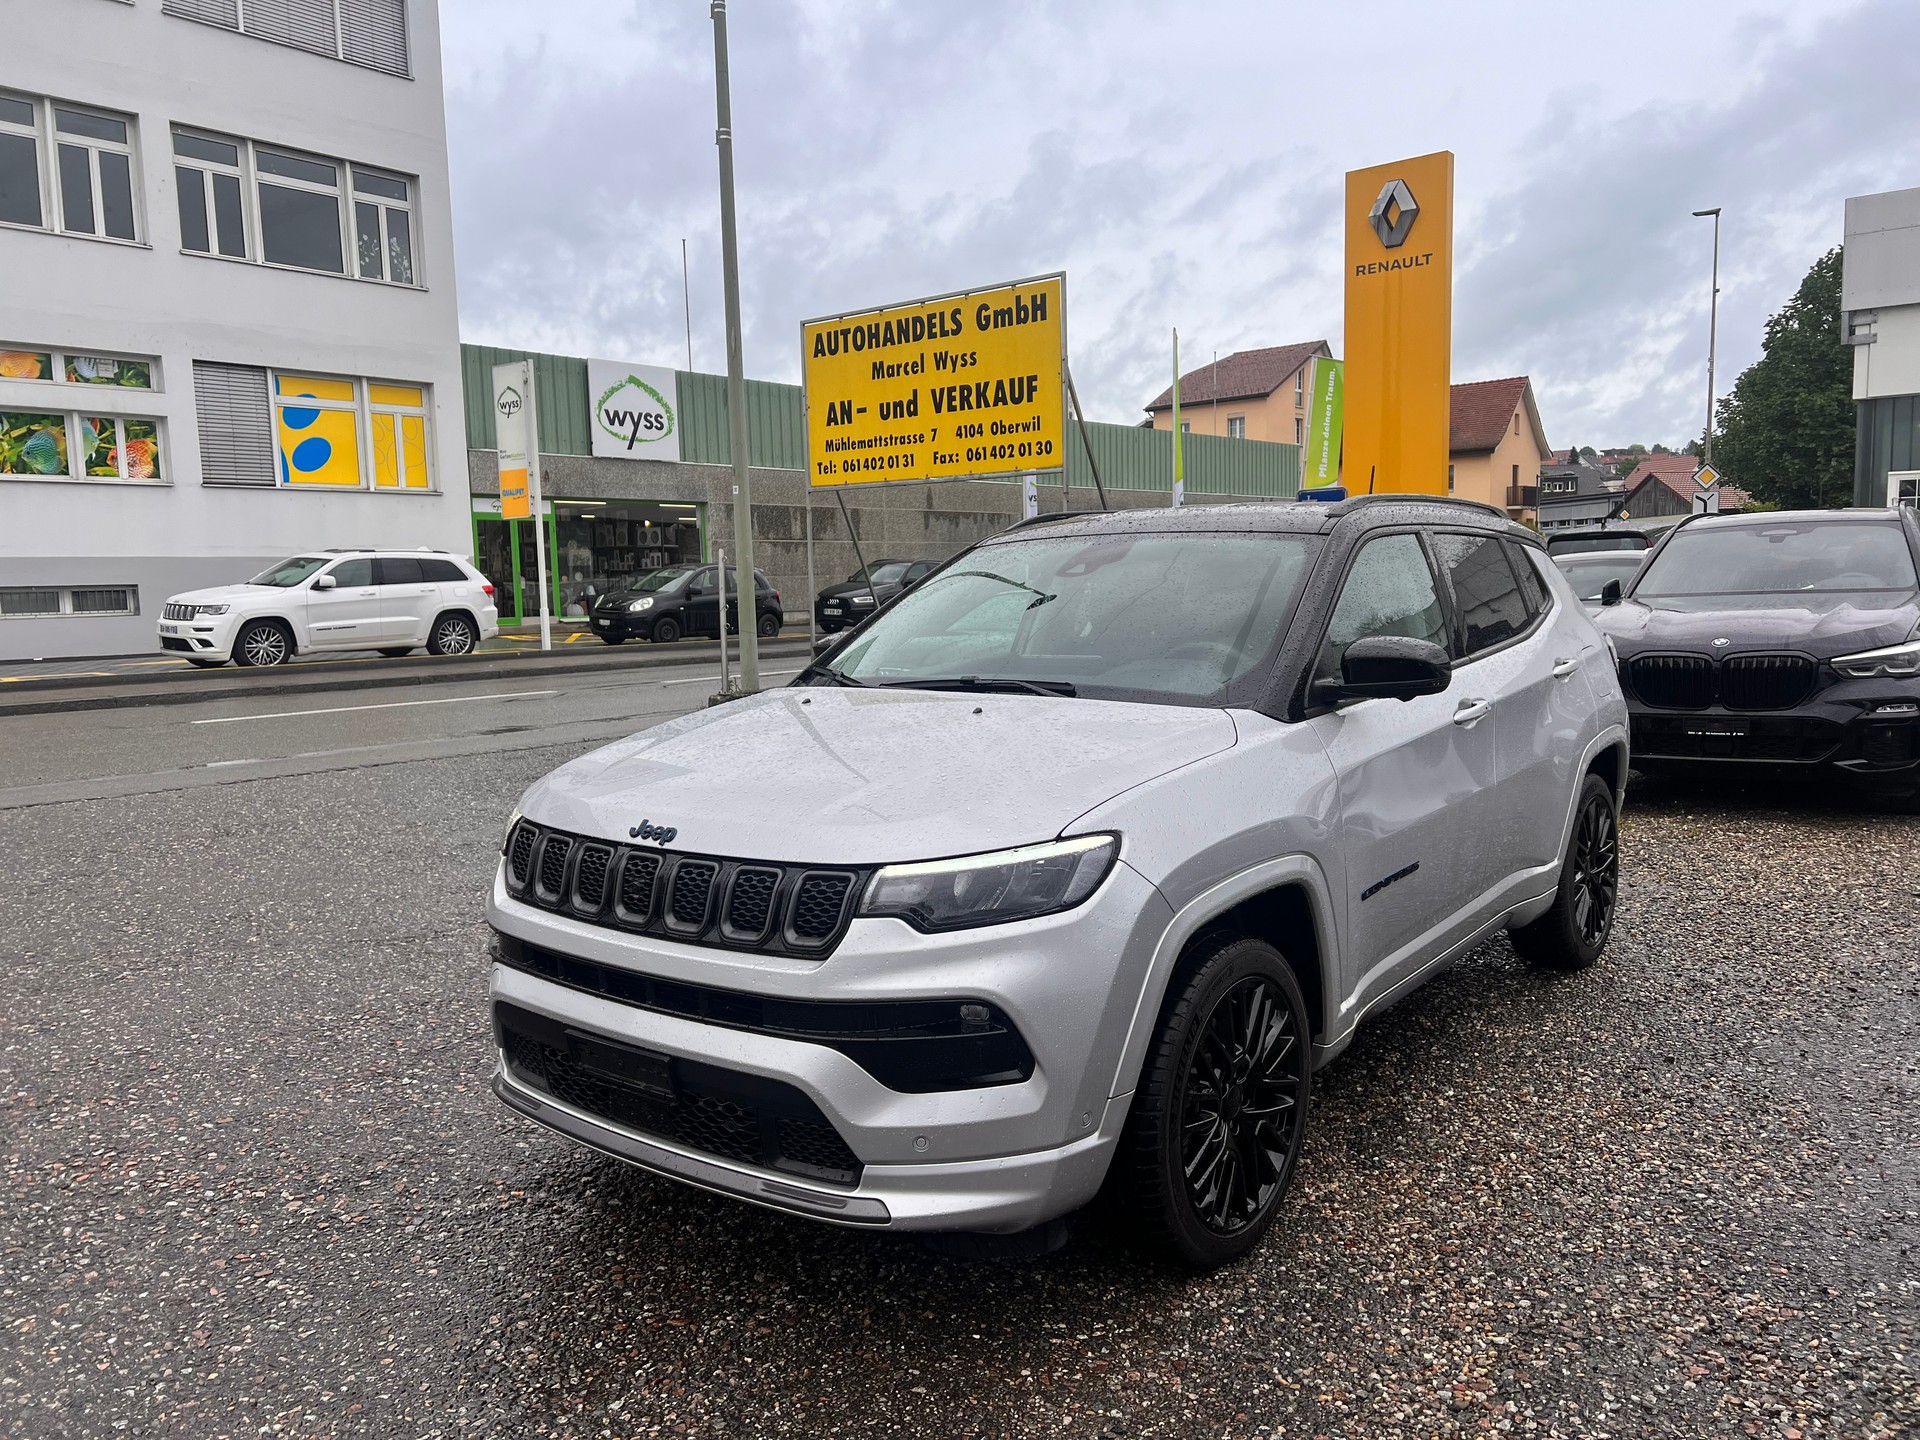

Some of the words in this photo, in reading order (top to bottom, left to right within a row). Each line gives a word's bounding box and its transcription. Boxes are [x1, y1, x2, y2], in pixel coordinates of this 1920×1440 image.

[1355, 253, 1433, 276] RENAULT
[813, 308, 962, 358] AUTOHANDELS
[976, 293, 1047, 331] GmbH
[871, 353, 925, 380] Marcel
[933, 351, 978, 373] Wyss
[879, 389, 918, 421] und
[931, 375, 1038, 414] VERKAUF
[1326, 368, 1336, 402] Traum.
[499, 400, 519, 419] wyss
[1323, 404, 1332, 438] deinen
[604, 408, 665, 450] wyss
[825, 428, 925, 453] Mühlemattstrasse
[931, 428, 938, 442] 7
[955, 423, 984, 439] 4104
[991, 416, 1041, 436] Oberwil
[817, 460, 837, 475] Tel:
[933, 449, 960, 465] Fax:
[1319, 441, 1329, 478] Pflanze
[629, 819, 677, 846] Jeep
